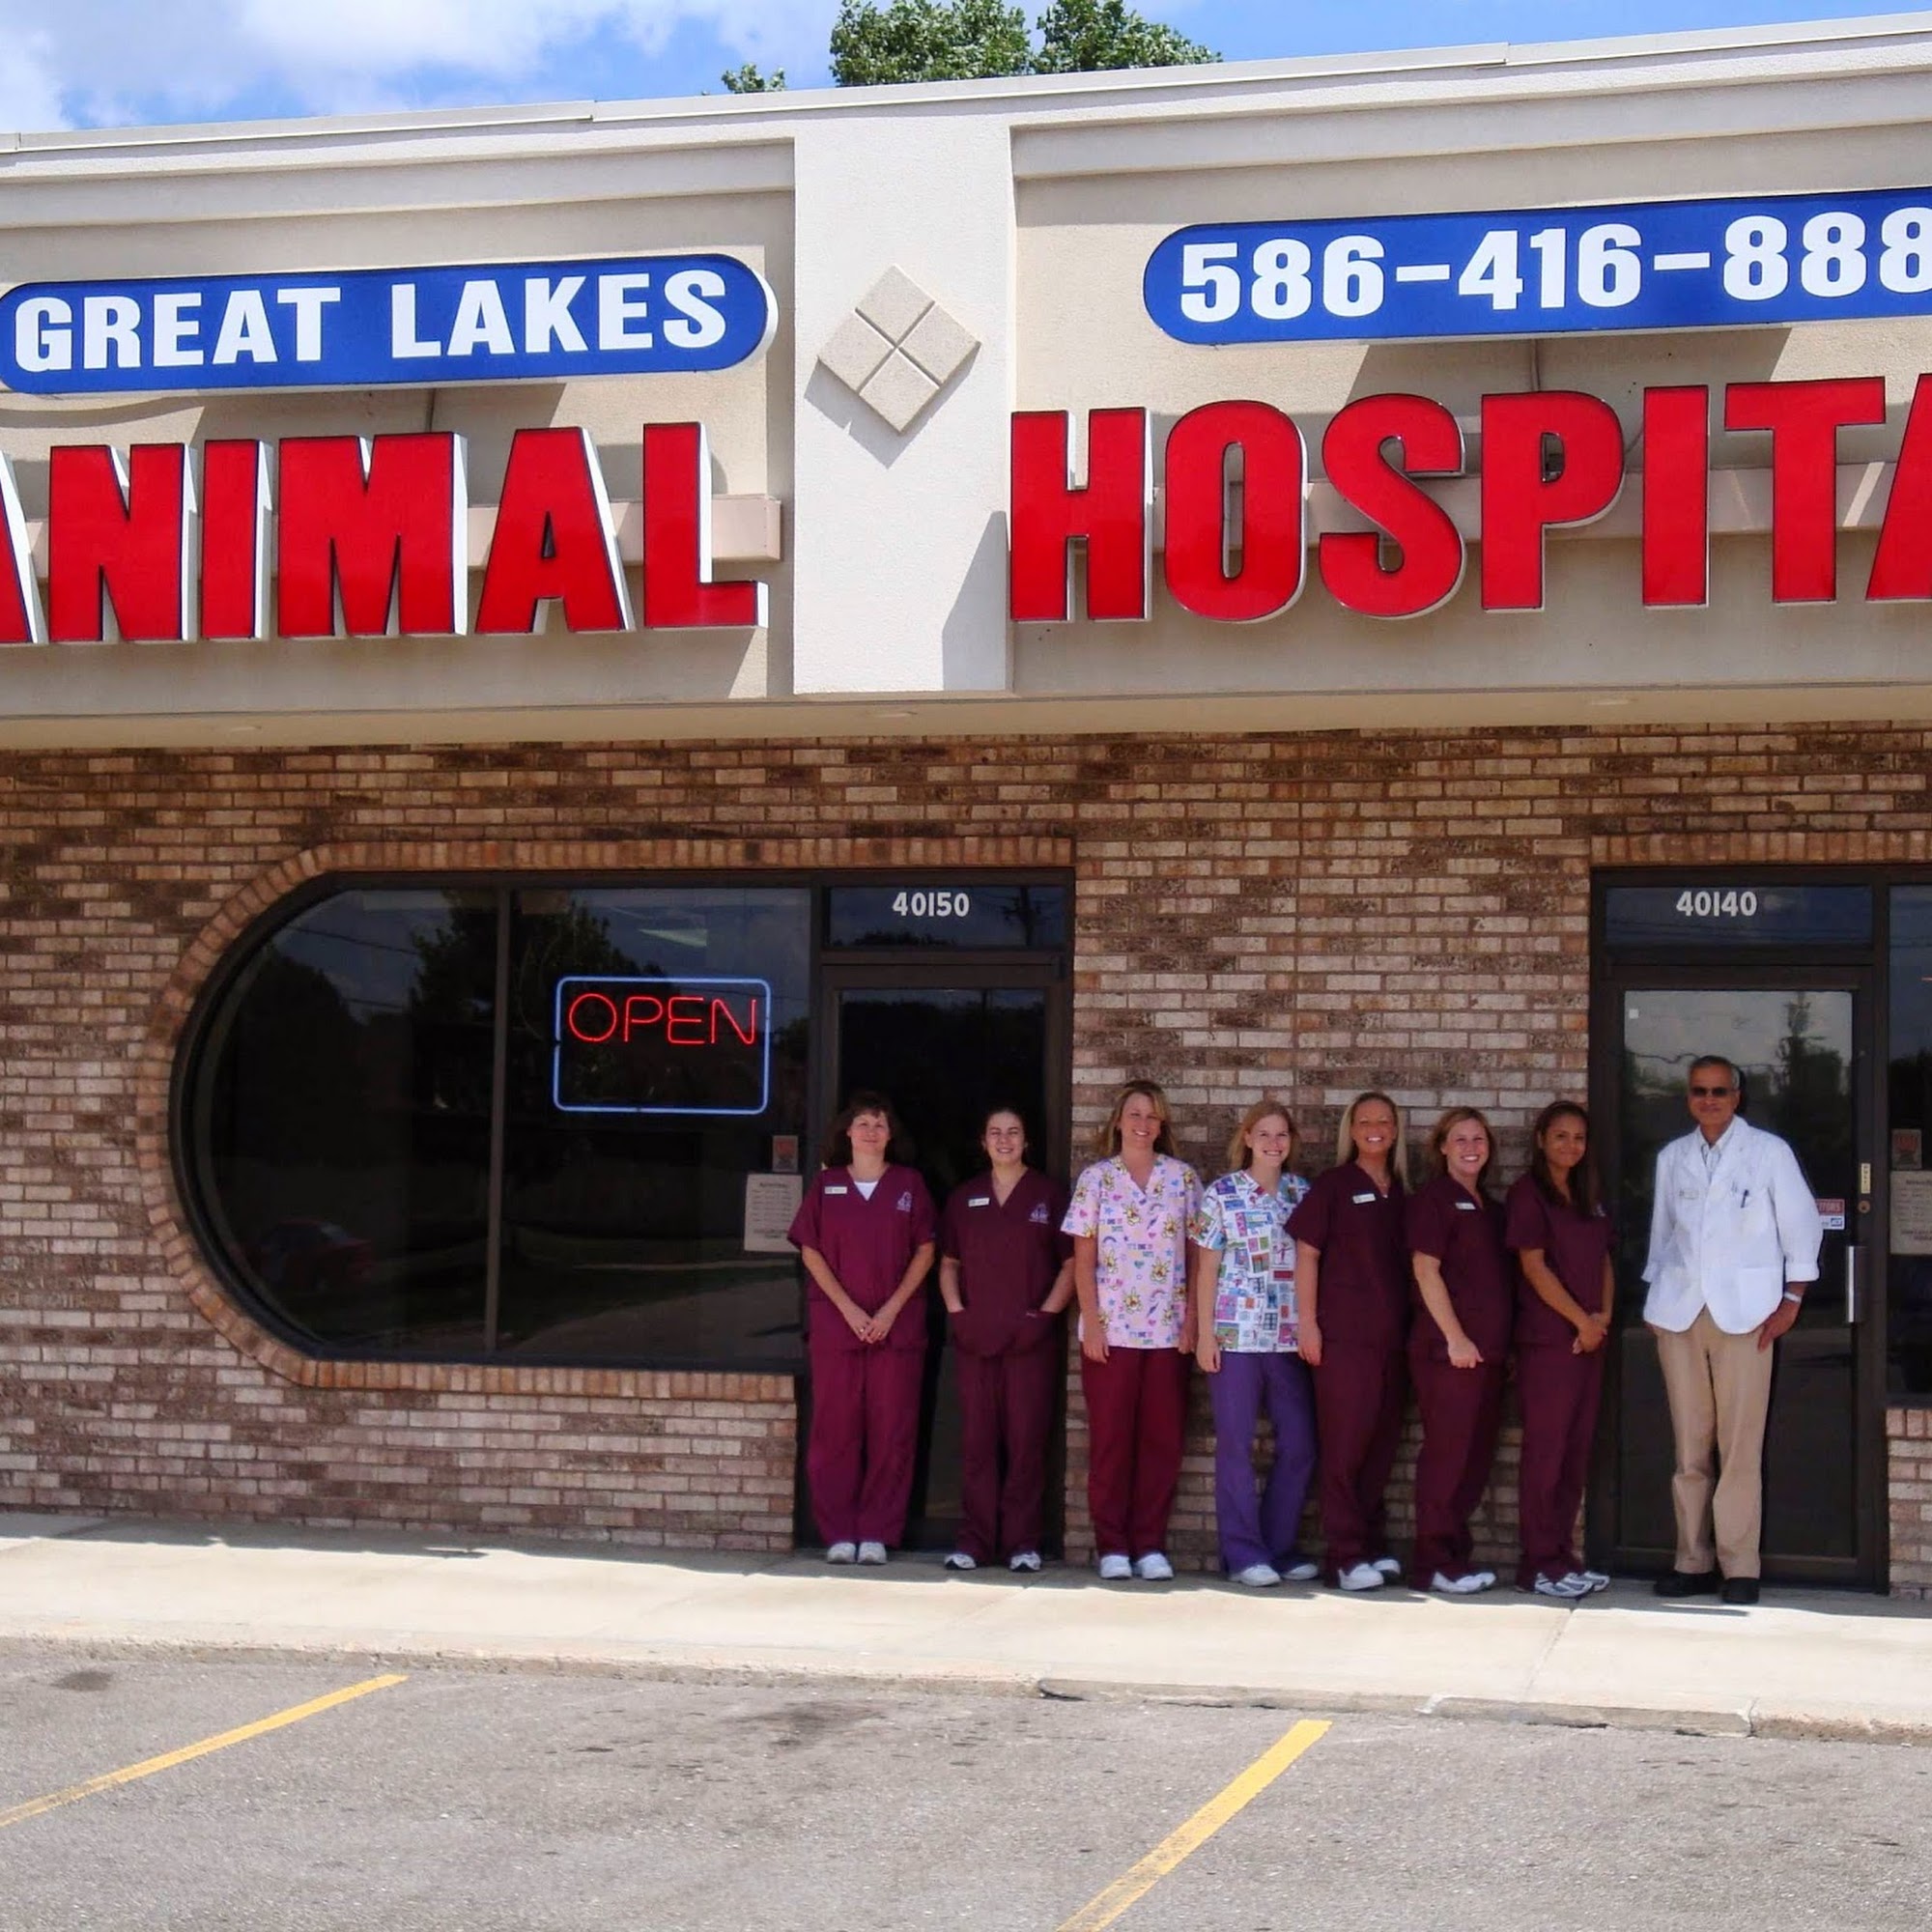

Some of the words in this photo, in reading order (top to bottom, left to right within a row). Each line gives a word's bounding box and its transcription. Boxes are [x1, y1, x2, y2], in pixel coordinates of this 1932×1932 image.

[14, 287, 342, 373] GREAT
[391, 270, 726, 359] LAKES
[892, 892, 970, 917] 40150
[1676, 891, 1757, 917] 40140
[568, 992, 757, 1045] OPEN
